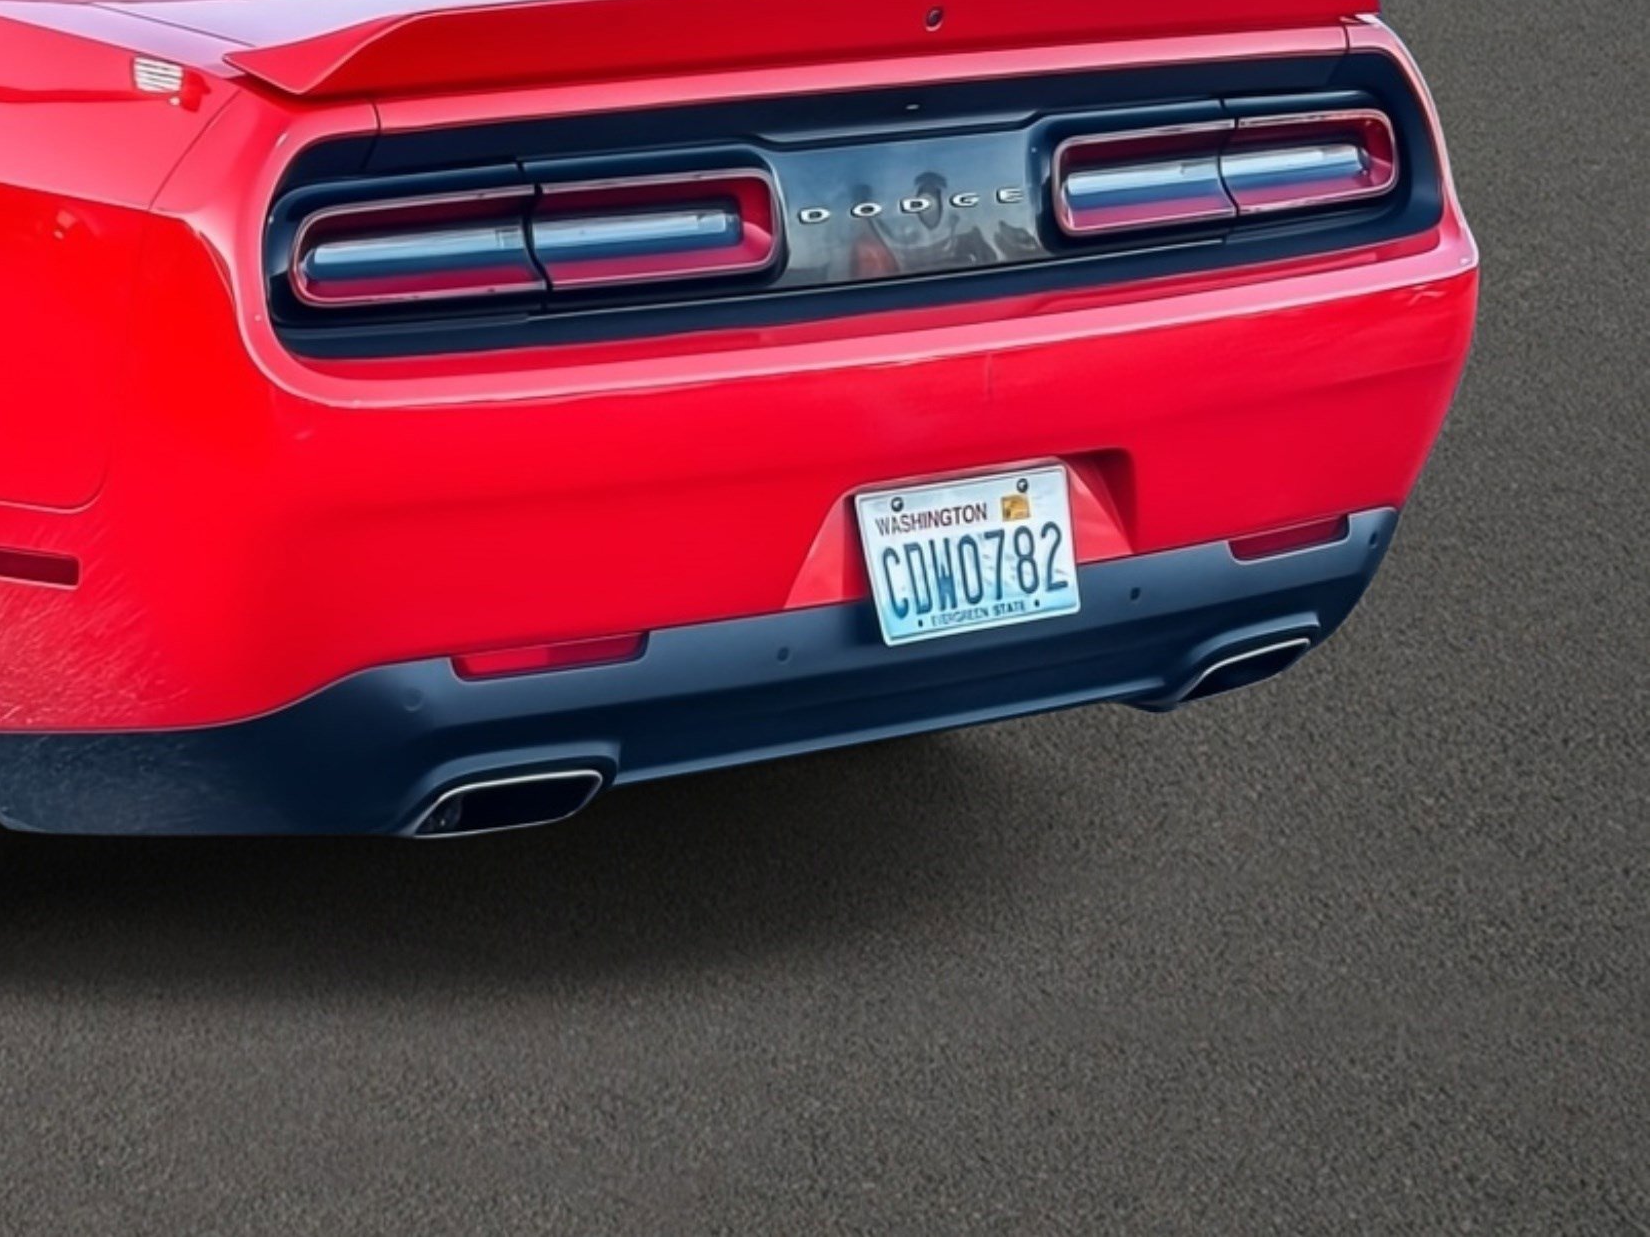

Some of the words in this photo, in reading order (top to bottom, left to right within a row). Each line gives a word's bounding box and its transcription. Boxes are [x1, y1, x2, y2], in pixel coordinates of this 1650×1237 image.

[798, 186, 1025, 225] DODGE
[874, 502, 988, 537] WASHINGTON
[881, 520, 1069, 620] CDW0782
[930, 604, 990, 628] EVERGREEN
[992, 600, 1028, 617] STATE
